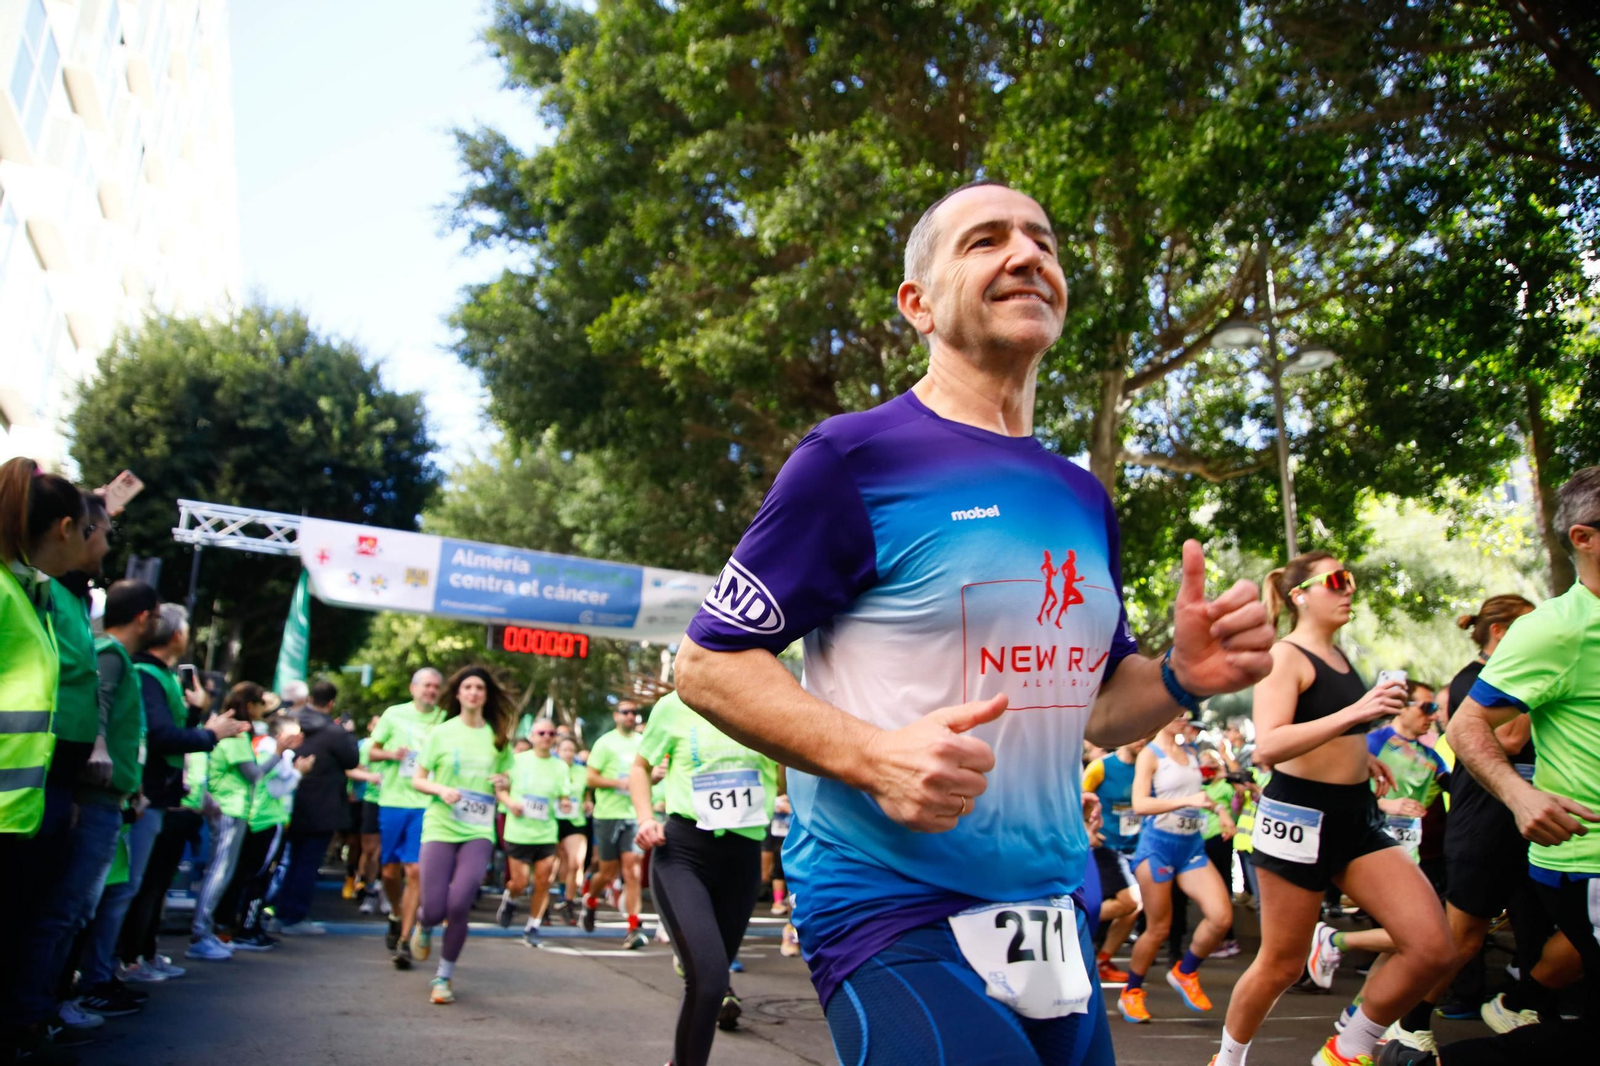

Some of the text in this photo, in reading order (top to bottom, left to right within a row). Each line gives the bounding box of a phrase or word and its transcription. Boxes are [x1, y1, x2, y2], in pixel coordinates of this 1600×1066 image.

[951, 504, 1001, 522] mobel
[452, 548, 531, 575] Almería
[449, 572, 517, 596] contra
[518, 579, 540, 598] el
[542, 583, 611, 606] cáncer
[980, 645, 1057, 675] NEW
[461, 800, 488, 816] 209
[709, 787, 753, 811] 611
[1260, 817, 1305, 844] 590
[994, 909, 1066, 965] 271
